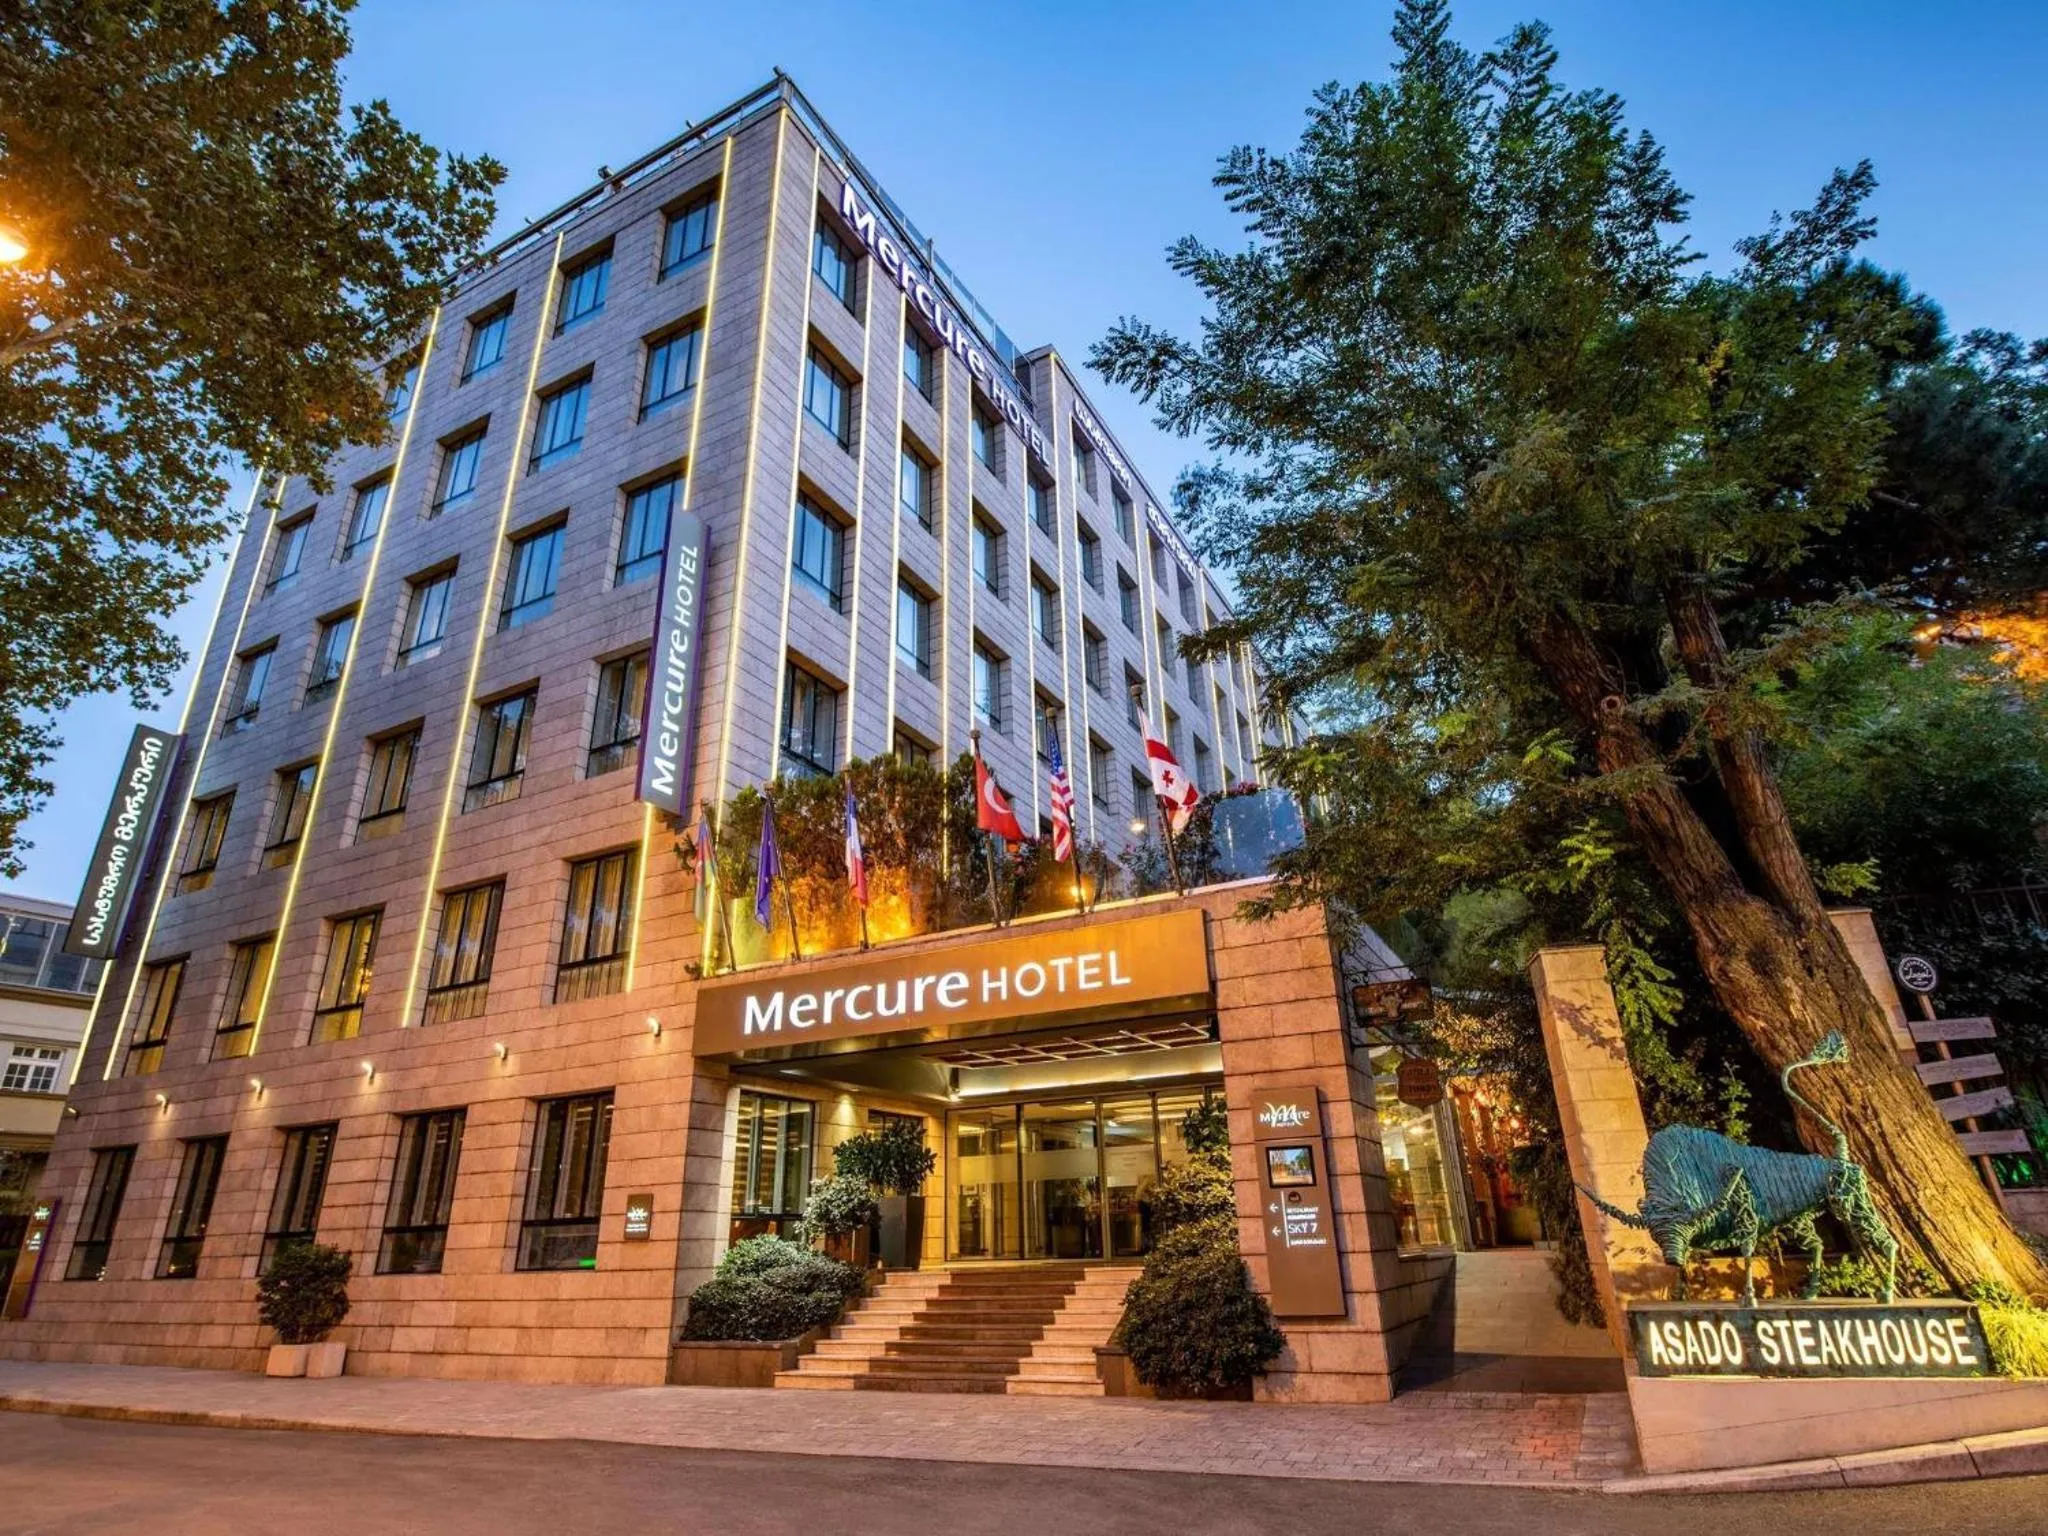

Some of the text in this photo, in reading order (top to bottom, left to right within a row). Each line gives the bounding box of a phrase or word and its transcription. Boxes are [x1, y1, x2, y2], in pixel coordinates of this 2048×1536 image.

[842, 182, 1050, 467] Mercure HOTEL
[651, 545, 699, 795] Mercure HOTEL
[82, 737, 163, 946] სასტუმრო მერკური
[743, 950, 1131, 1036] Mercure HOTEL
[1288, 1222, 1318, 1234] SKY 7
[1649, 1317, 1978, 1366] ASADO STEAKHOUSE
